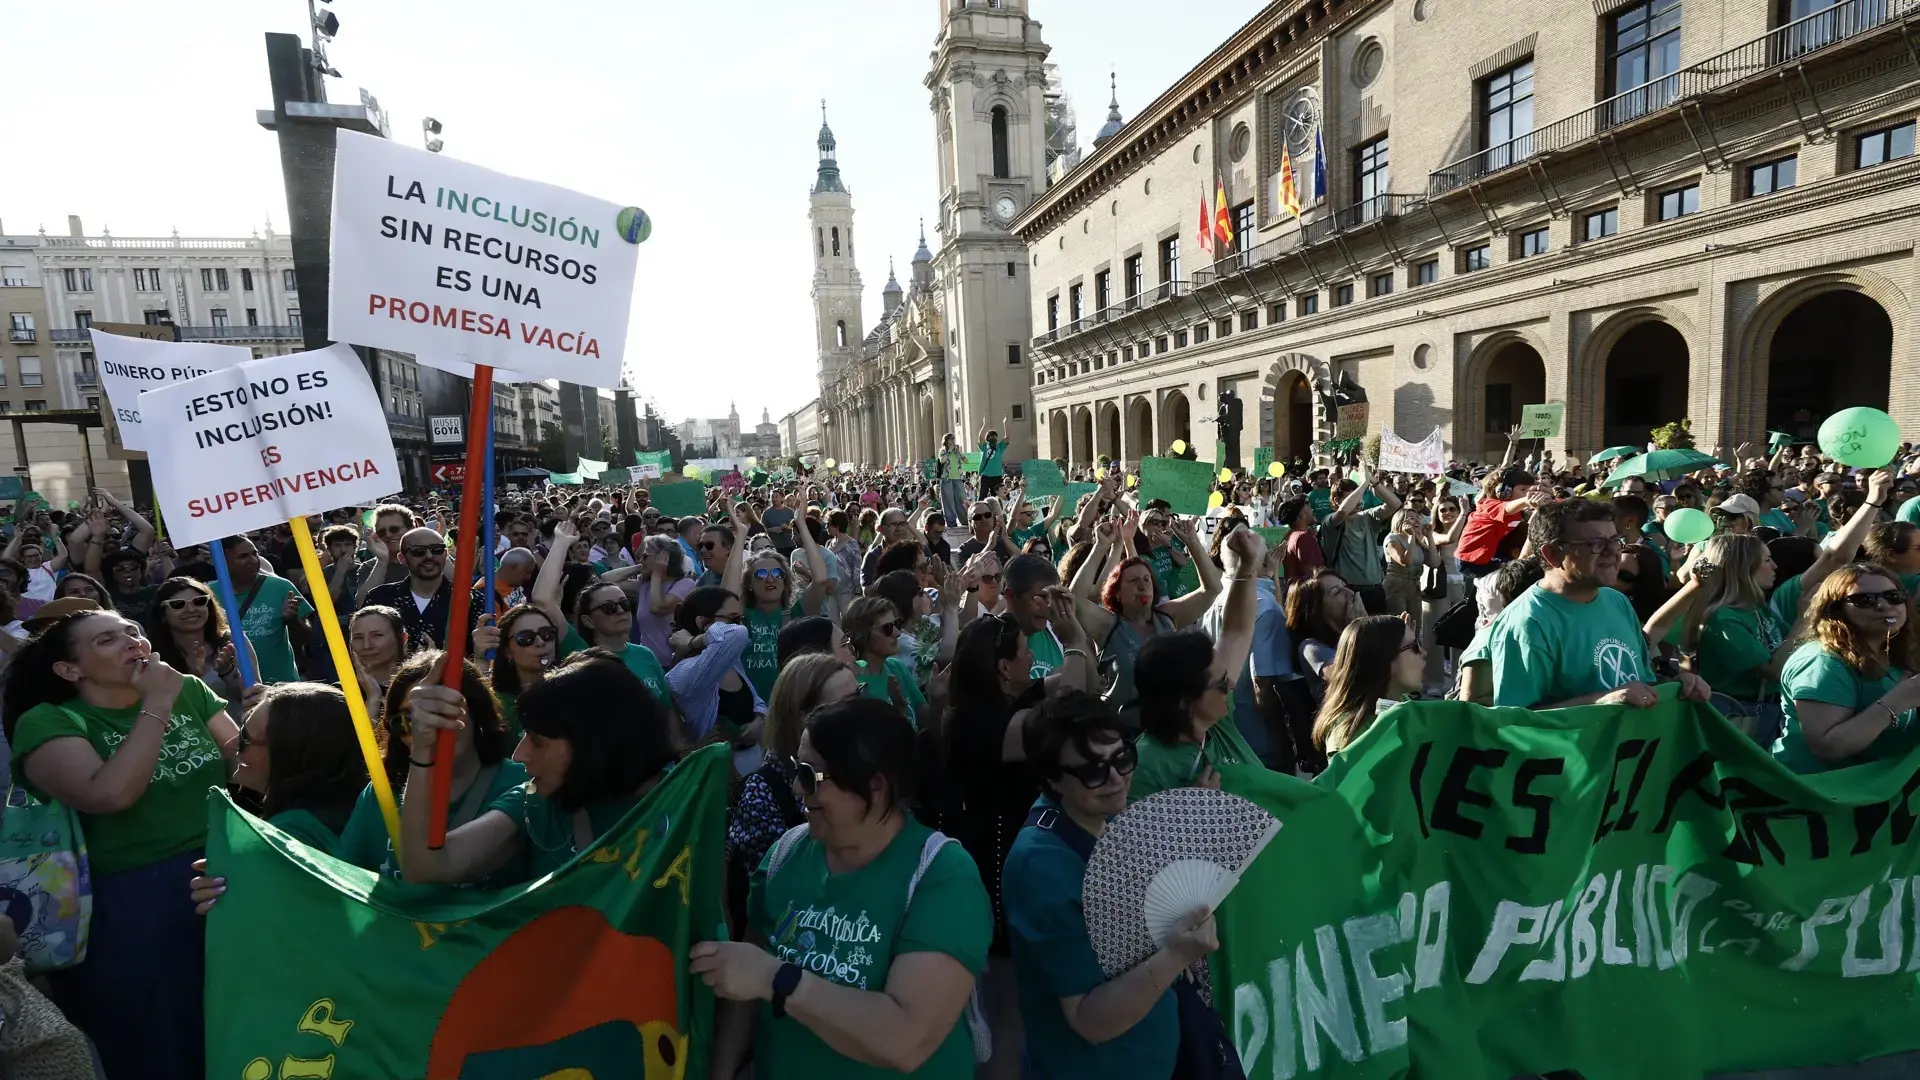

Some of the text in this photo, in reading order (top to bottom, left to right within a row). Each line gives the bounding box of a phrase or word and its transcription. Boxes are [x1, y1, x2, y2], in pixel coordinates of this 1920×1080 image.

[387, 175, 426, 204] LA
[436, 187, 600, 249] INCLUSIÓN
[380, 215, 597, 285] SIN RECURSOS
[436, 265, 542, 309] ES UNA
[368, 293, 600, 359] PROMESA VACÍA
[104, 360, 166, 381] DINERO
[185, 370, 328, 422] ¡ESTO NO ES
[1534, 412, 1552, 420] TODOS
[195, 401, 333, 449] INCLUSIÓN!
[433, 418, 459, 427] MUSEO
[434, 426, 460, 436] GOYA
[1532, 427, 1551, 437] TODOS
[259, 445, 282, 467] ES
[188, 458, 380, 518] SUPERVIVENCIA
